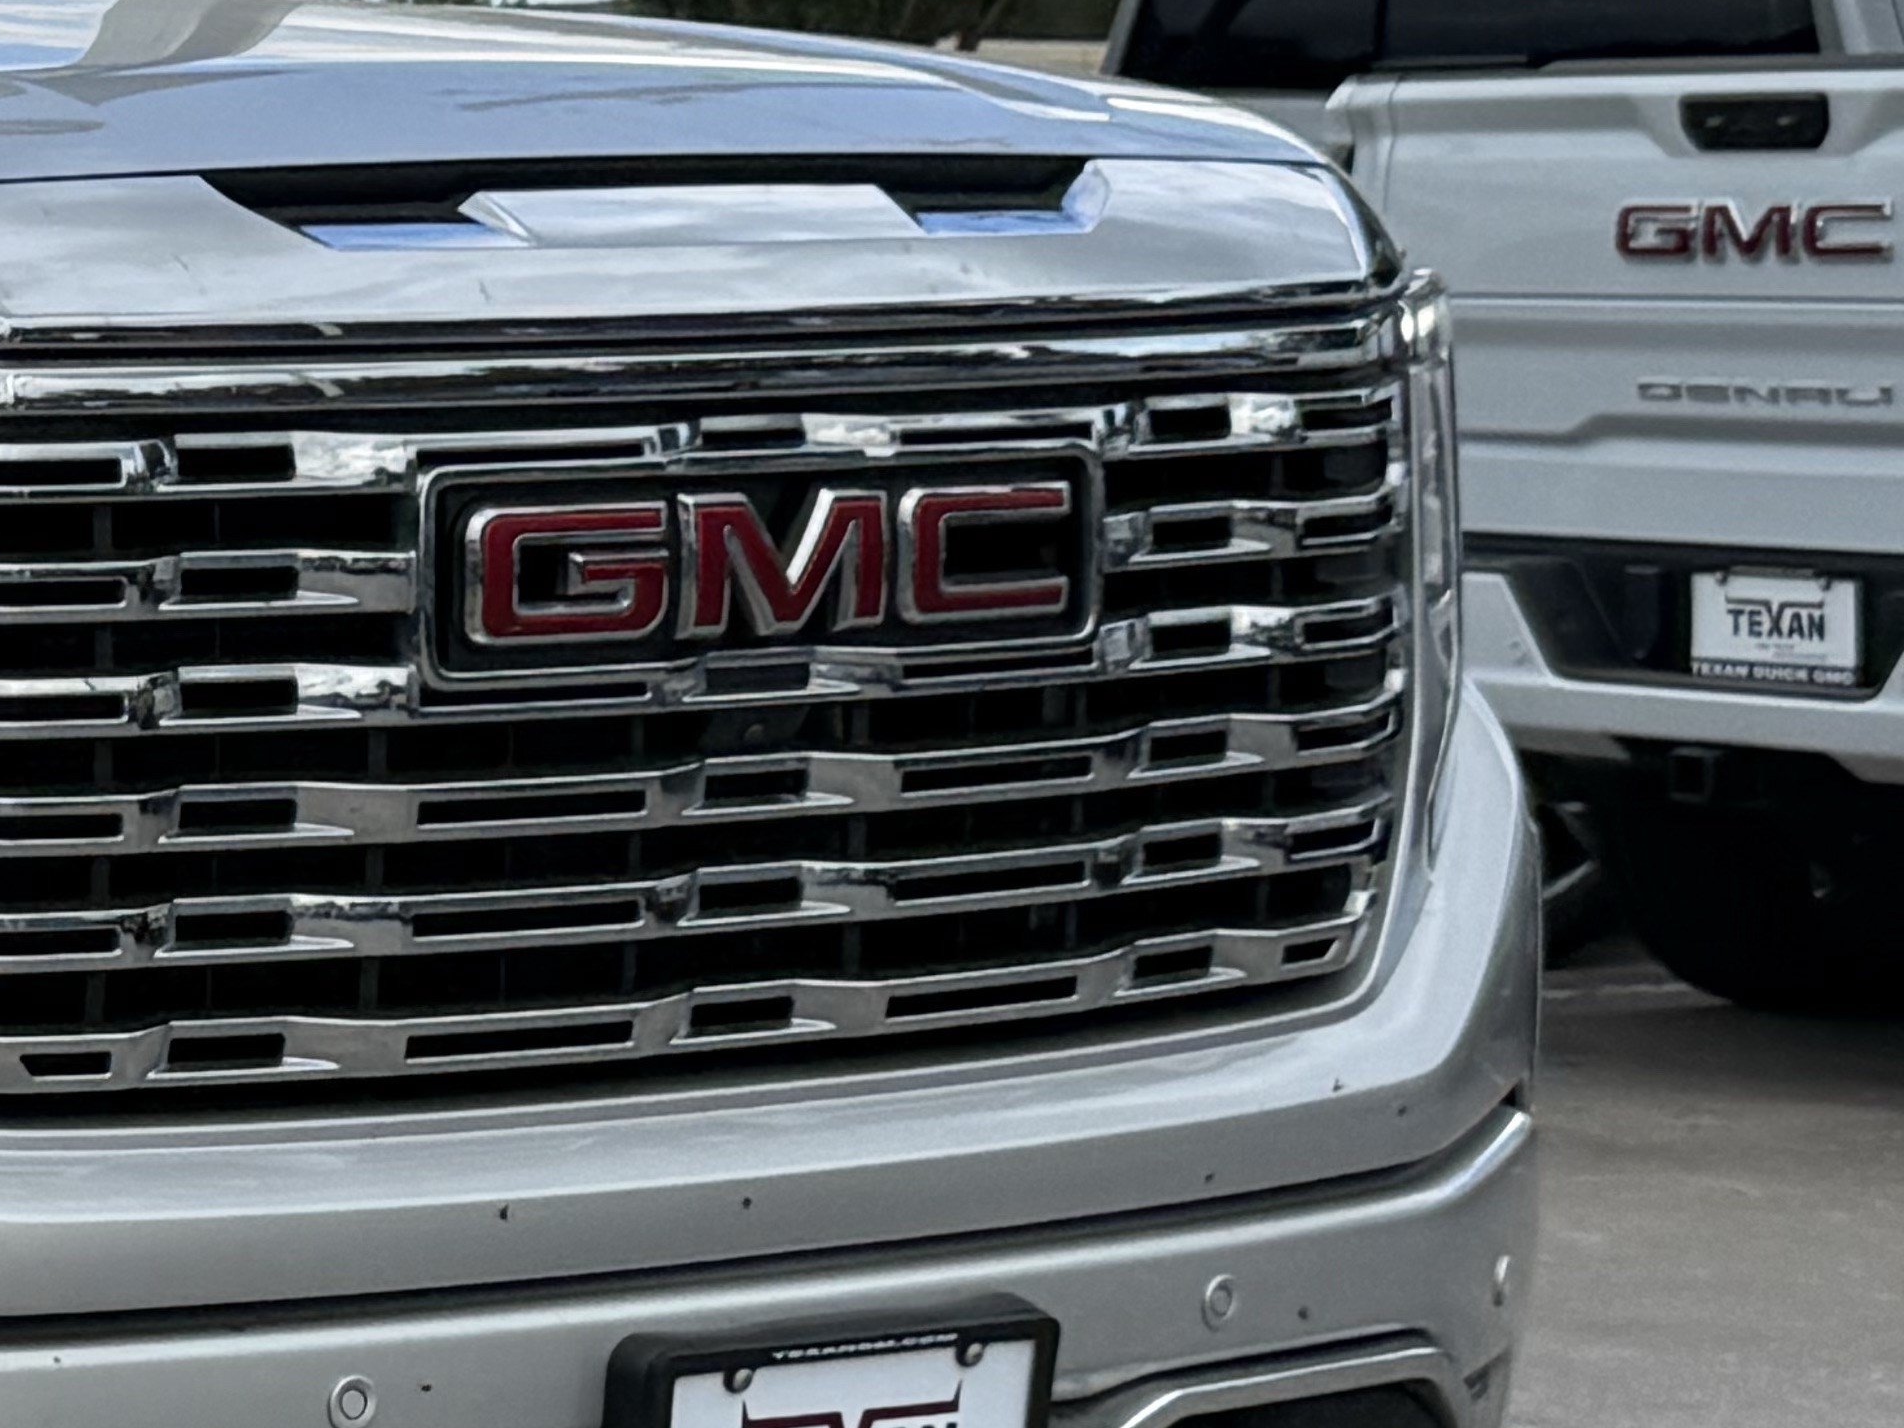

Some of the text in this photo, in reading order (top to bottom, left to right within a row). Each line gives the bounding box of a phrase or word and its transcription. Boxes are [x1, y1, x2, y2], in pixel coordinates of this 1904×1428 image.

[1615, 199, 1894, 262] GMC
[464, 480, 1071, 646] GMC
[1726, 599, 1826, 642] TEXAN
